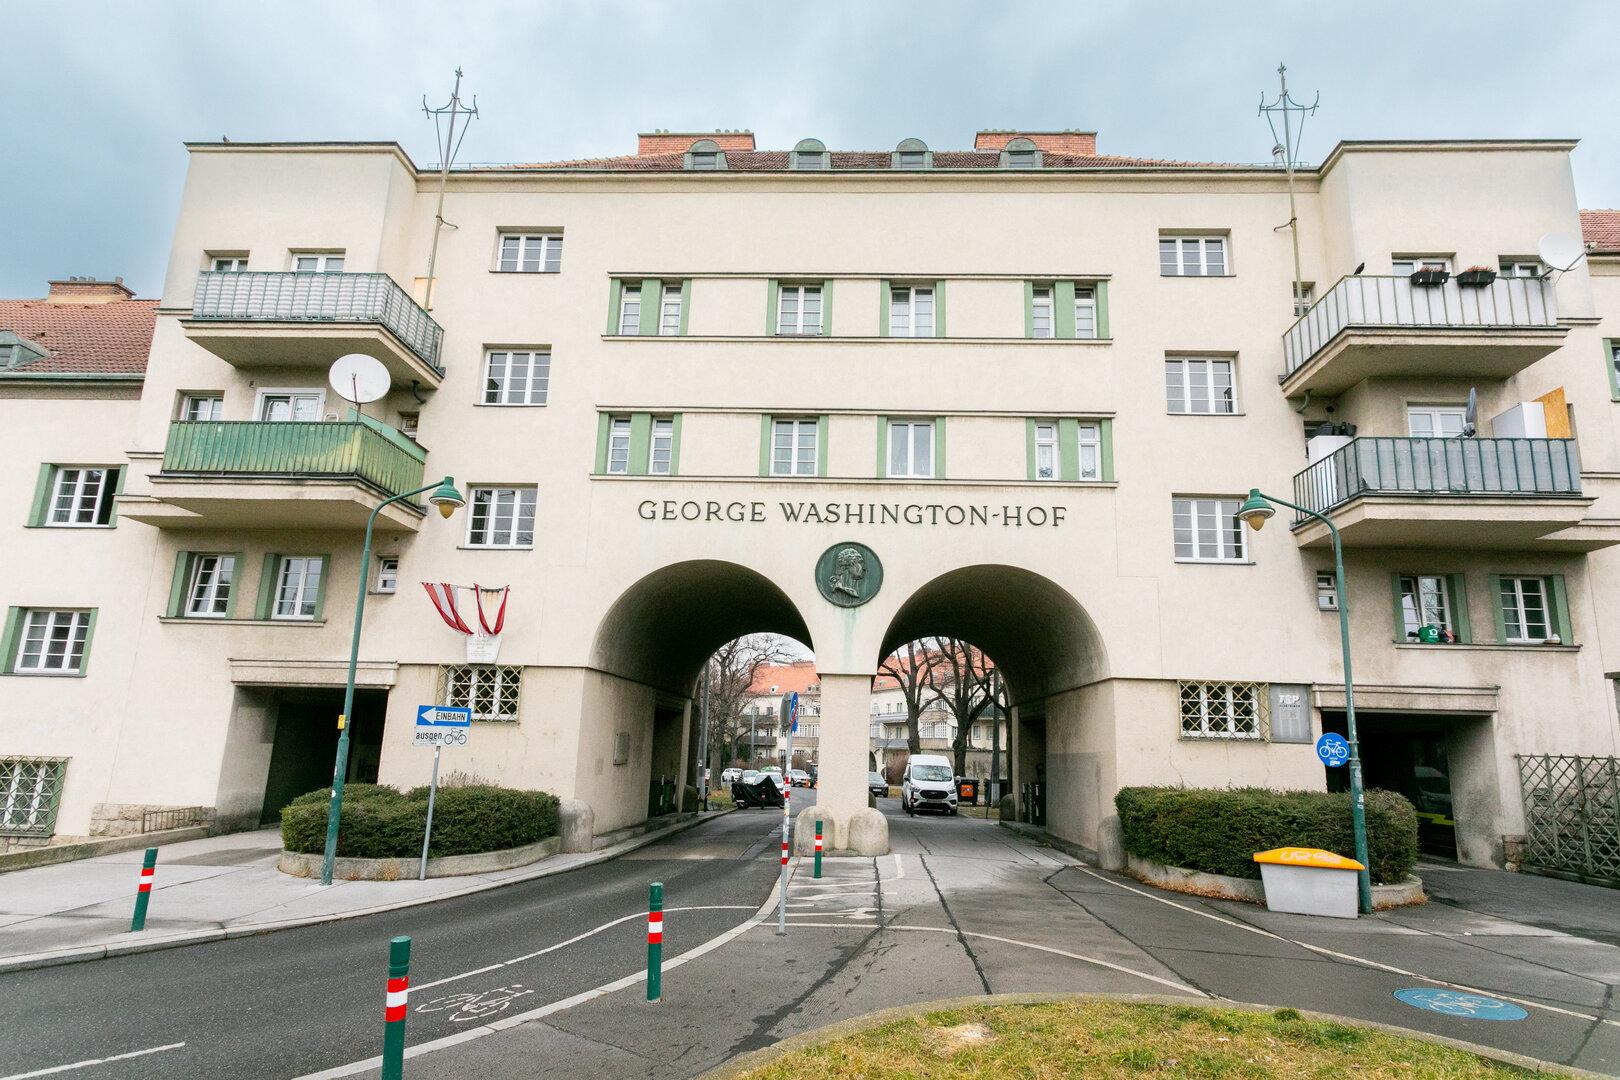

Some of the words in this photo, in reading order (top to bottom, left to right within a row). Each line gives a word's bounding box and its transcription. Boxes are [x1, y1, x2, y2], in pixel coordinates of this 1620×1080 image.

[637, 500, 767, 523] GEORGE
[778, 502, 1067, 527] WASHINGTON-HOF
[435, 711, 466, 721] EINBAHN
